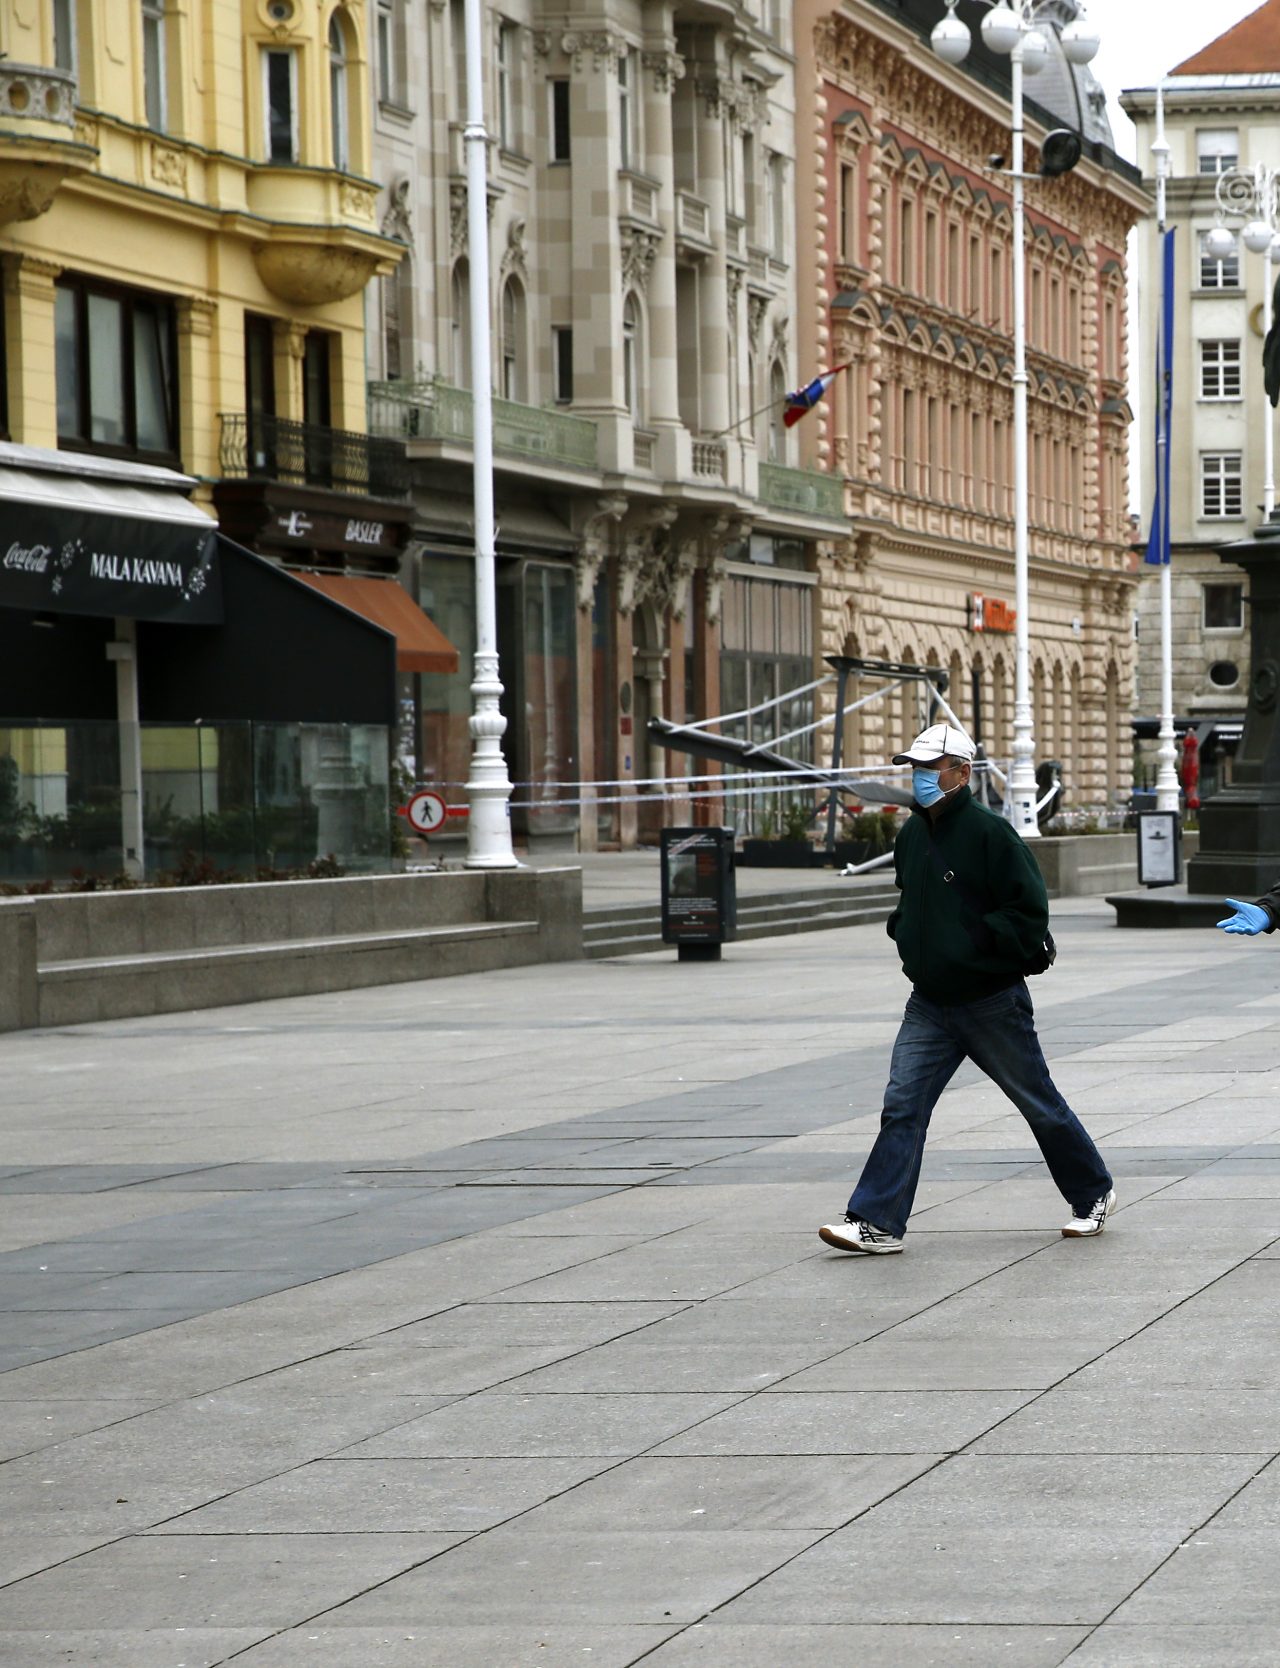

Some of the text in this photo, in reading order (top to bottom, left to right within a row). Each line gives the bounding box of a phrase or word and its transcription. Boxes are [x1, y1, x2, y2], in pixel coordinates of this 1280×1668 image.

[345, 520, 383, 544] BASLER
[90, 553, 183, 587] MALA KAVANA
